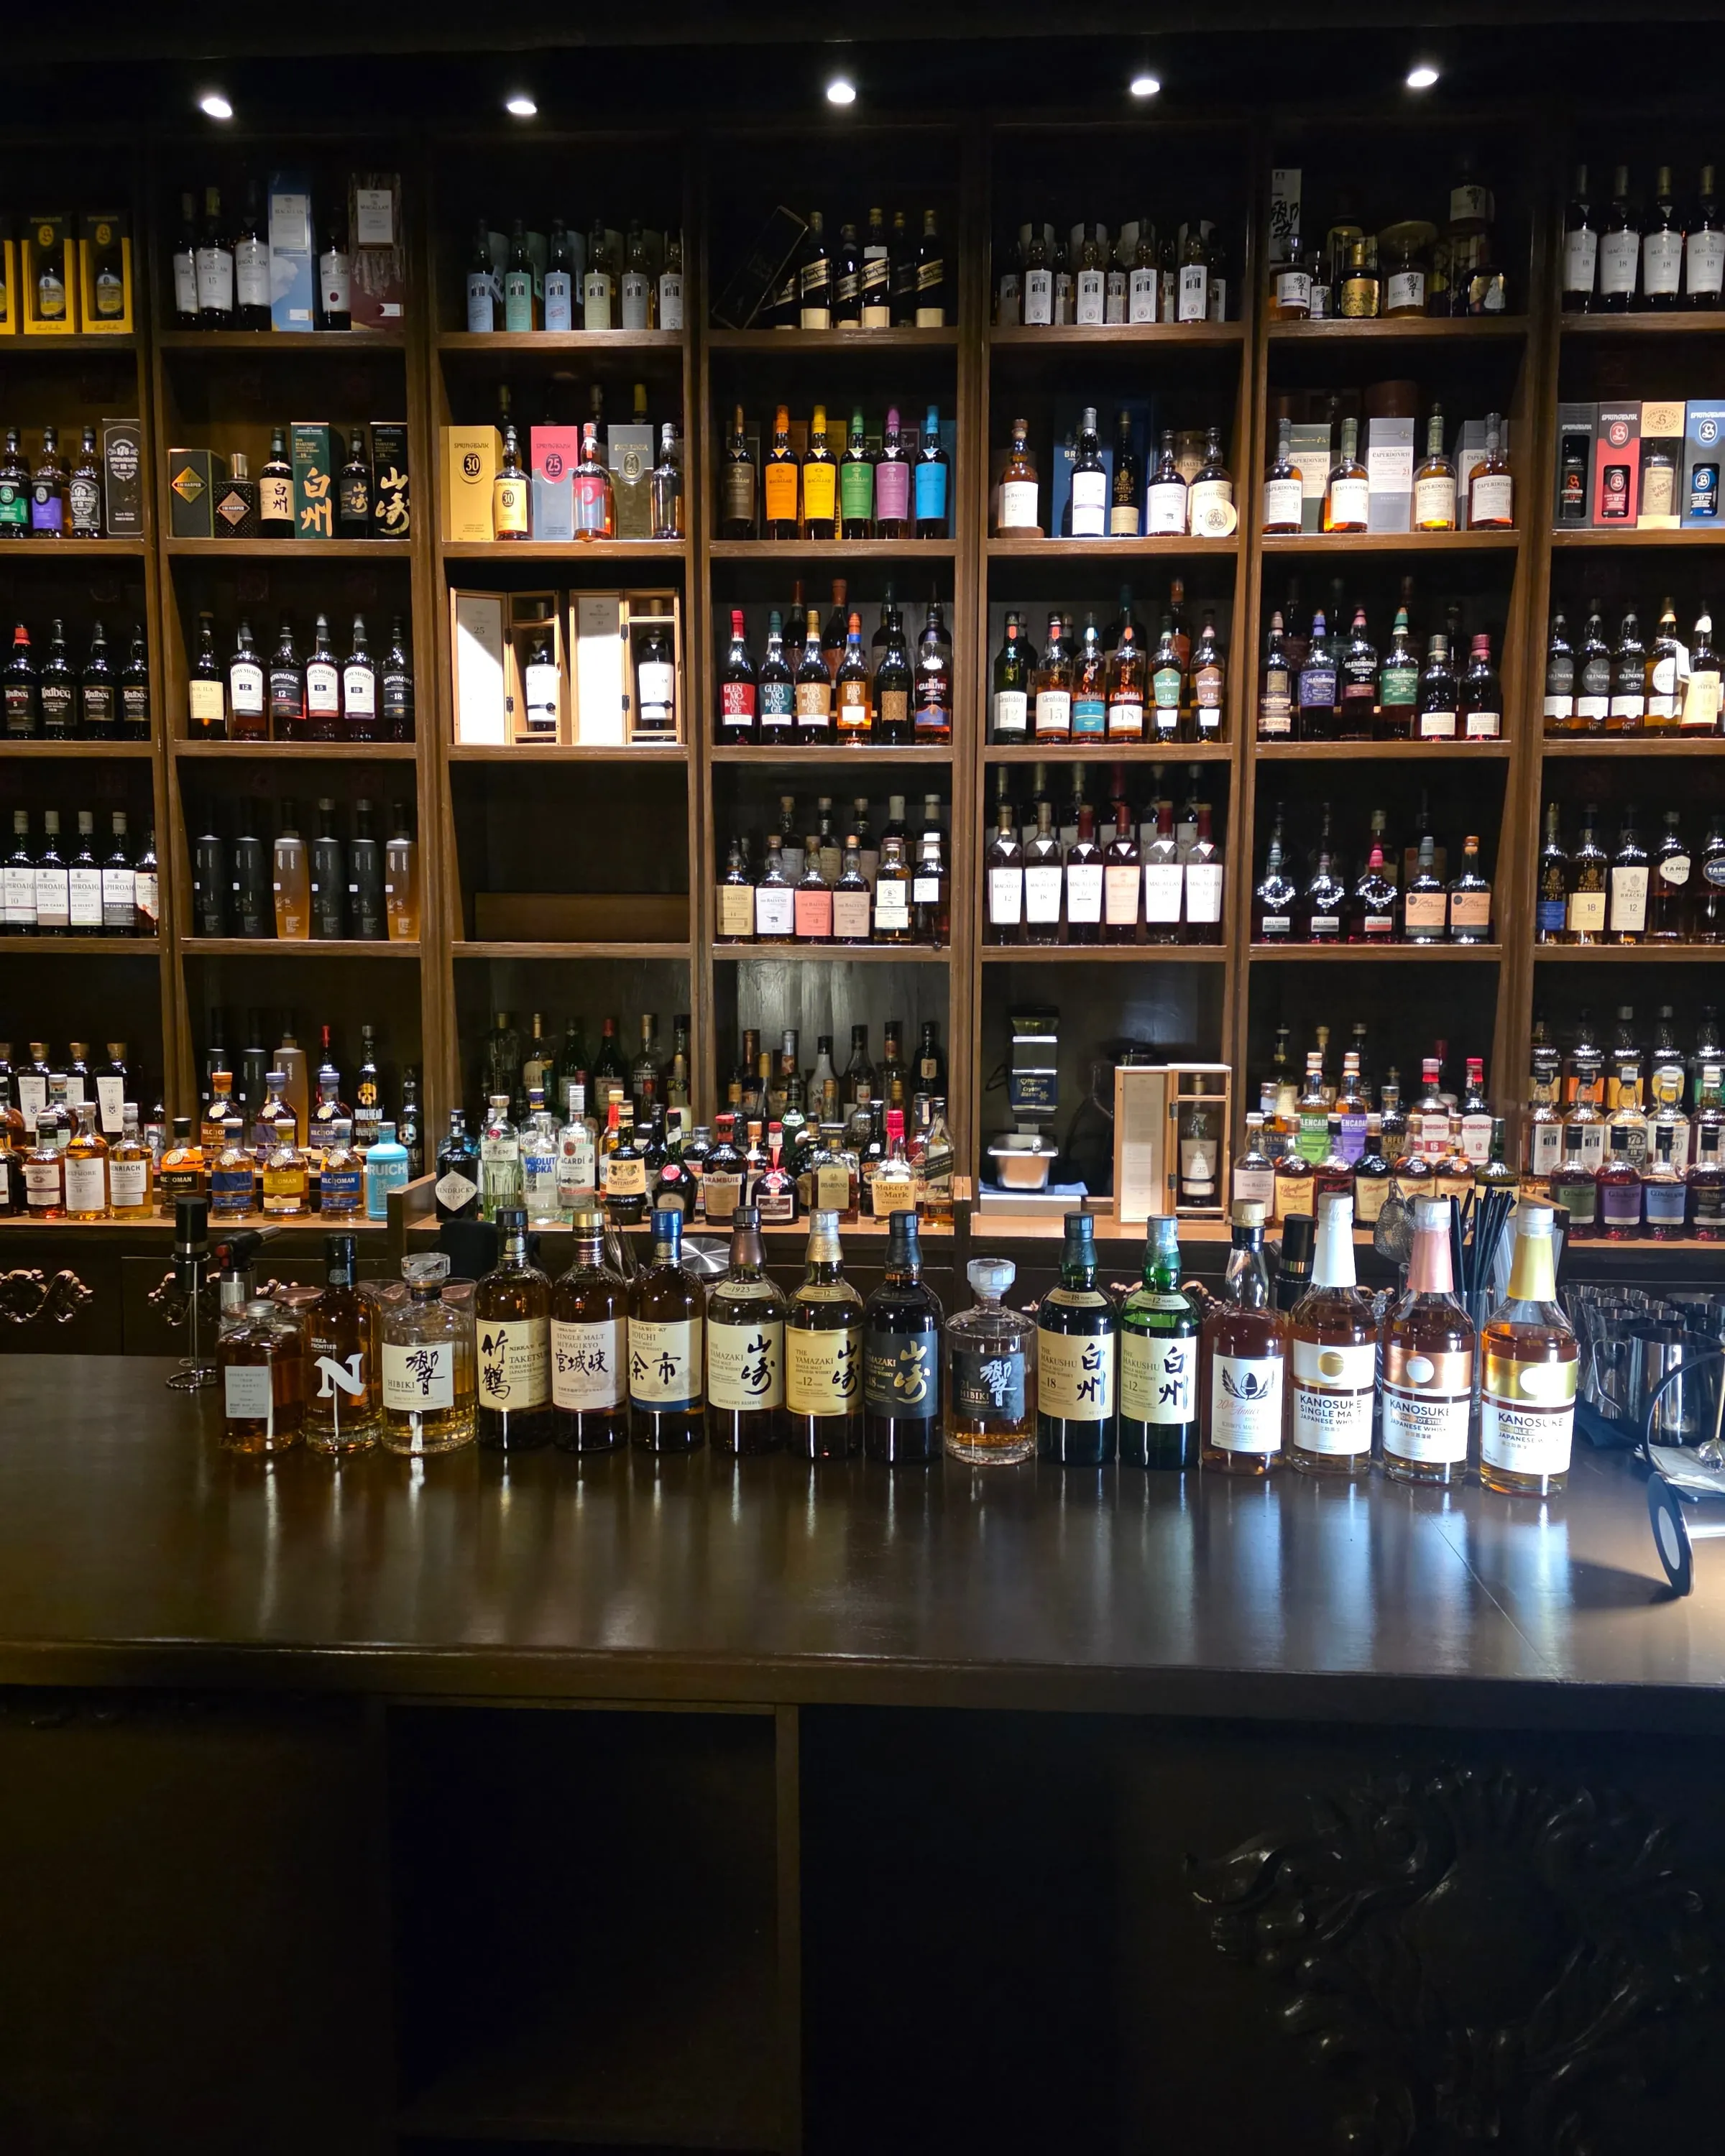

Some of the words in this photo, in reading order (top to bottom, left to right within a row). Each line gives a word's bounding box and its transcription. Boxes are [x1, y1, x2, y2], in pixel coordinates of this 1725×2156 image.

[466, 457, 481, 471] 30
[548, 459, 561, 472] 25
[273, 482, 287, 514] 白州
[300, 467, 332, 537] 白州
[375, 467, 410, 535] 山崎
[503, 494, 513, 502] 30
[474, 626, 485, 635] 25
[232, 667, 260, 678] BOWMORE
[270, 672, 299, 683] BOWMORE
[308, 668, 336, 679] BOWMORE
[42, 687, 71, 699] Ardbeg
[1005, 707, 1018, 720] 12
[1049, 707, 1063, 720] 15
[1121, 707, 1134, 720] 18
[1300, 1119, 1328, 1128] LENCADA
[556, 1349, 608, 1376] 宮城峡
[710, 1350, 743, 1362] YAMAZAKI
[796, 1356, 834, 1365] YAMAZAKI
[1041, 1355, 1077, 1368] HAKUSHU
[481, 1330, 510, 1400] 竹鶴
[630, 1351, 681, 1385] 余市
[741, 1334, 775, 1395] 山崎
[832, 1340, 859, 1398] 山崎
[1123, 1358, 1159, 1371] HAKUSHU
[314, 1353, 366, 1398] N
[406, 1350, 445, 1395] 響
[893, 1340, 931, 1404] 山崎
[1077, 1342, 1105, 1406] 白州
[1159, 1346, 1189, 1409] 白州
[387, 1379, 415, 1388] HIBIKI
[803, 1376, 812, 1386] 12
[980, 1360, 1017, 1407] 響
[1046, 1377, 1057, 1388] 18
[1128, 1381, 1138, 1391] 12
[960, 1390, 989, 1400] HIBIKI
[1300, 1394, 1362, 1409] KANOSUKE
[1300, 1405, 1334, 1417] SINGLE
[1390, 1399, 1449, 1416] KANOSUKE
[1300, 1414, 1333, 1424] JAPANESE
[1390, 1419, 1422, 1431] JAPANESE
[1499, 1411, 1563, 1427] KANOSUKE
[1499, 1432, 1535, 1443] JAPANESE
